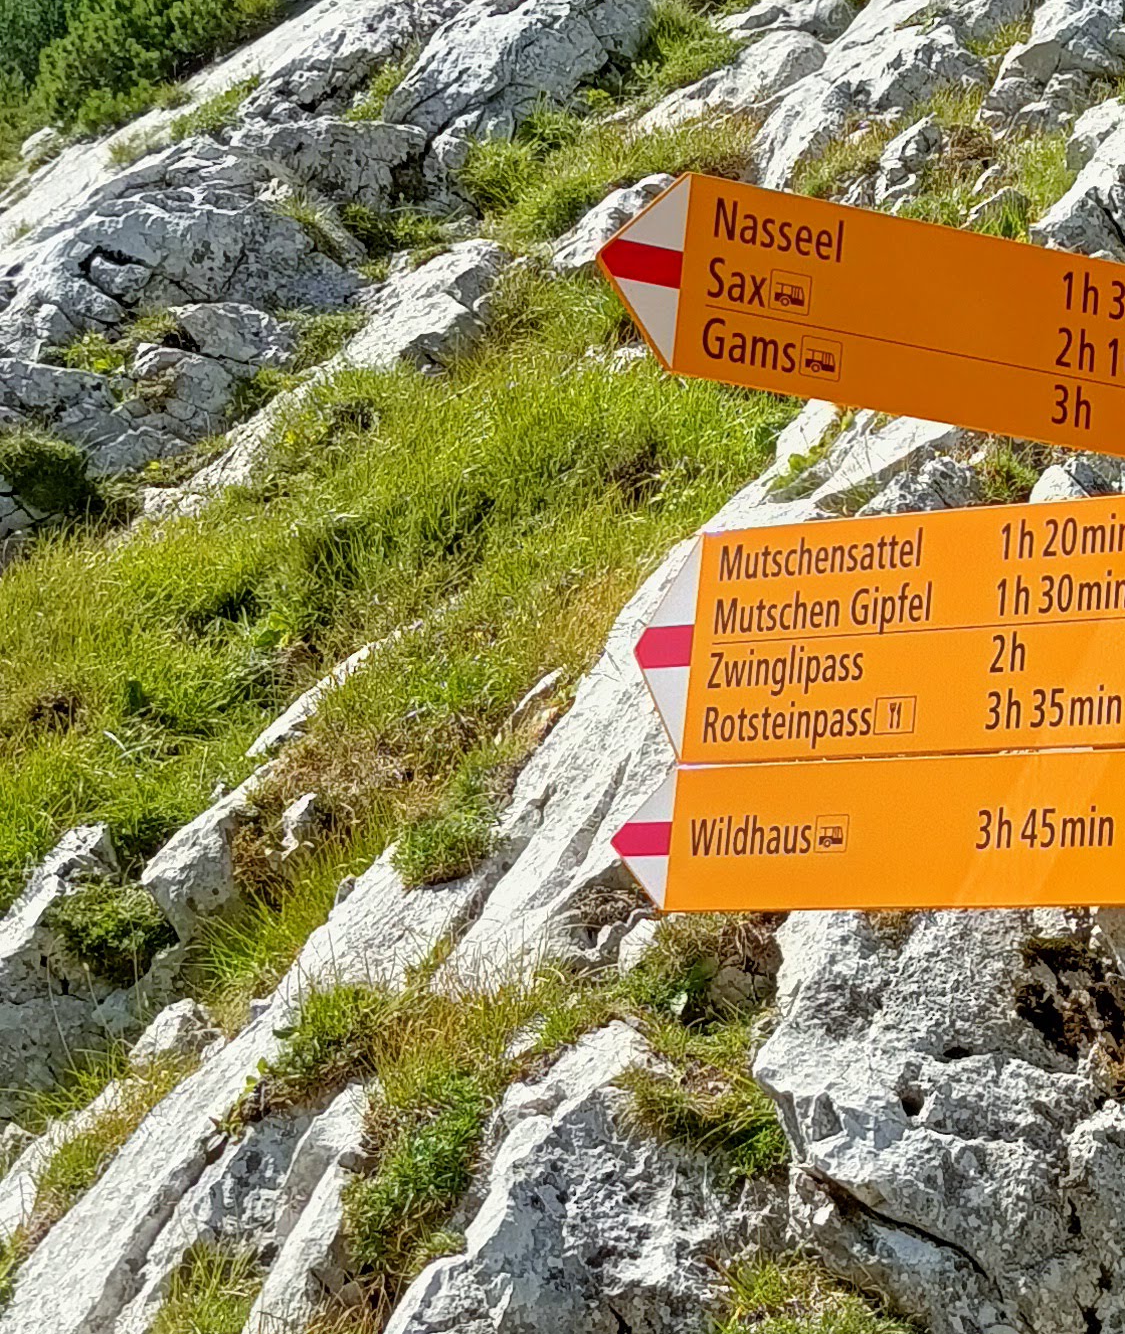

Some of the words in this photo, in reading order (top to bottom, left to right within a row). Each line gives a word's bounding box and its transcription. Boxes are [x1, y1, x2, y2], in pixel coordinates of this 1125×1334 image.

[713, 197, 845, 263] Nasseel
[706, 258, 769, 308] Sax
[1061, 271, 1099, 315] 1h
[702, 317, 796, 373] Gams
[1055, 328, 1096, 373] 2h
[1051, 385, 1092, 429] 3h
[718, 528, 923, 583] Mutschensattel
[1000, 521, 1033, 560] 1h
[712, 589, 840, 637] Mutschen
[851, 581, 933, 633] Gipfel
[996, 577, 1030, 617] 1h
[707, 647, 864, 696] Zwinglipass
[989, 633, 1026, 673] 2h
[702, 700, 871, 749] Rotsteinpass
[984, 691, 1023, 731] 3h
[1030, 684, 1123, 728] 35min
[690, 817, 813, 857] Wildhaus
[975, 811, 1012, 851] 3h
[1020, 806, 1114, 849] 45min
